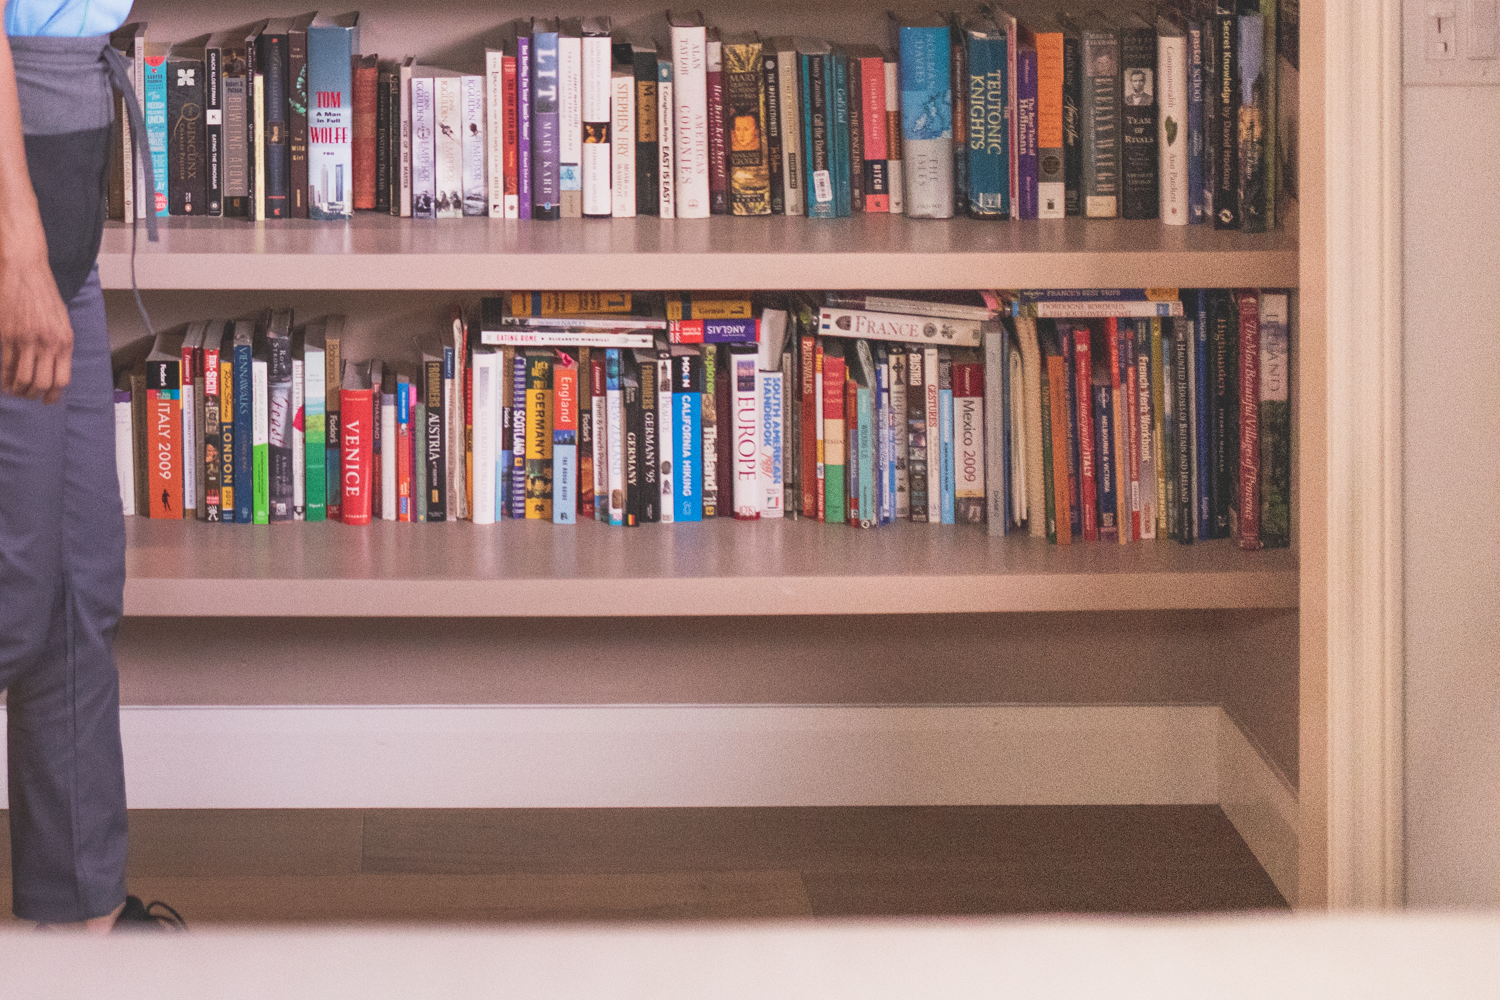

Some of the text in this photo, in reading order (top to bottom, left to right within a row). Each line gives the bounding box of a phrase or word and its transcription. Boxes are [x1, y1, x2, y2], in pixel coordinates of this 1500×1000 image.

[316, 91, 341, 108] TOM
[537, 49, 556, 194] LIT MARY KARR
[617, 84, 628, 157] STEPHEN FRY
[310, 127, 348, 143] WOLFE
[873, 164, 883, 190] BITCH
[560, 376, 574, 423] England
[682, 395, 692, 458] CALIFORNIA
[704, 347, 716, 490] Explorer Thailand
[158, 403, 171, 480] ITALY 2009
[223, 425, 232, 483] LONDON
[345, 420, 360, 497] VENICE
[428, 412, 440, 460] AUSTRIA
[627, 432, 636, 485] GERMANY
[737, 397, 756, 480] EUROPE
[683, 460, 692, 496] HIKING
